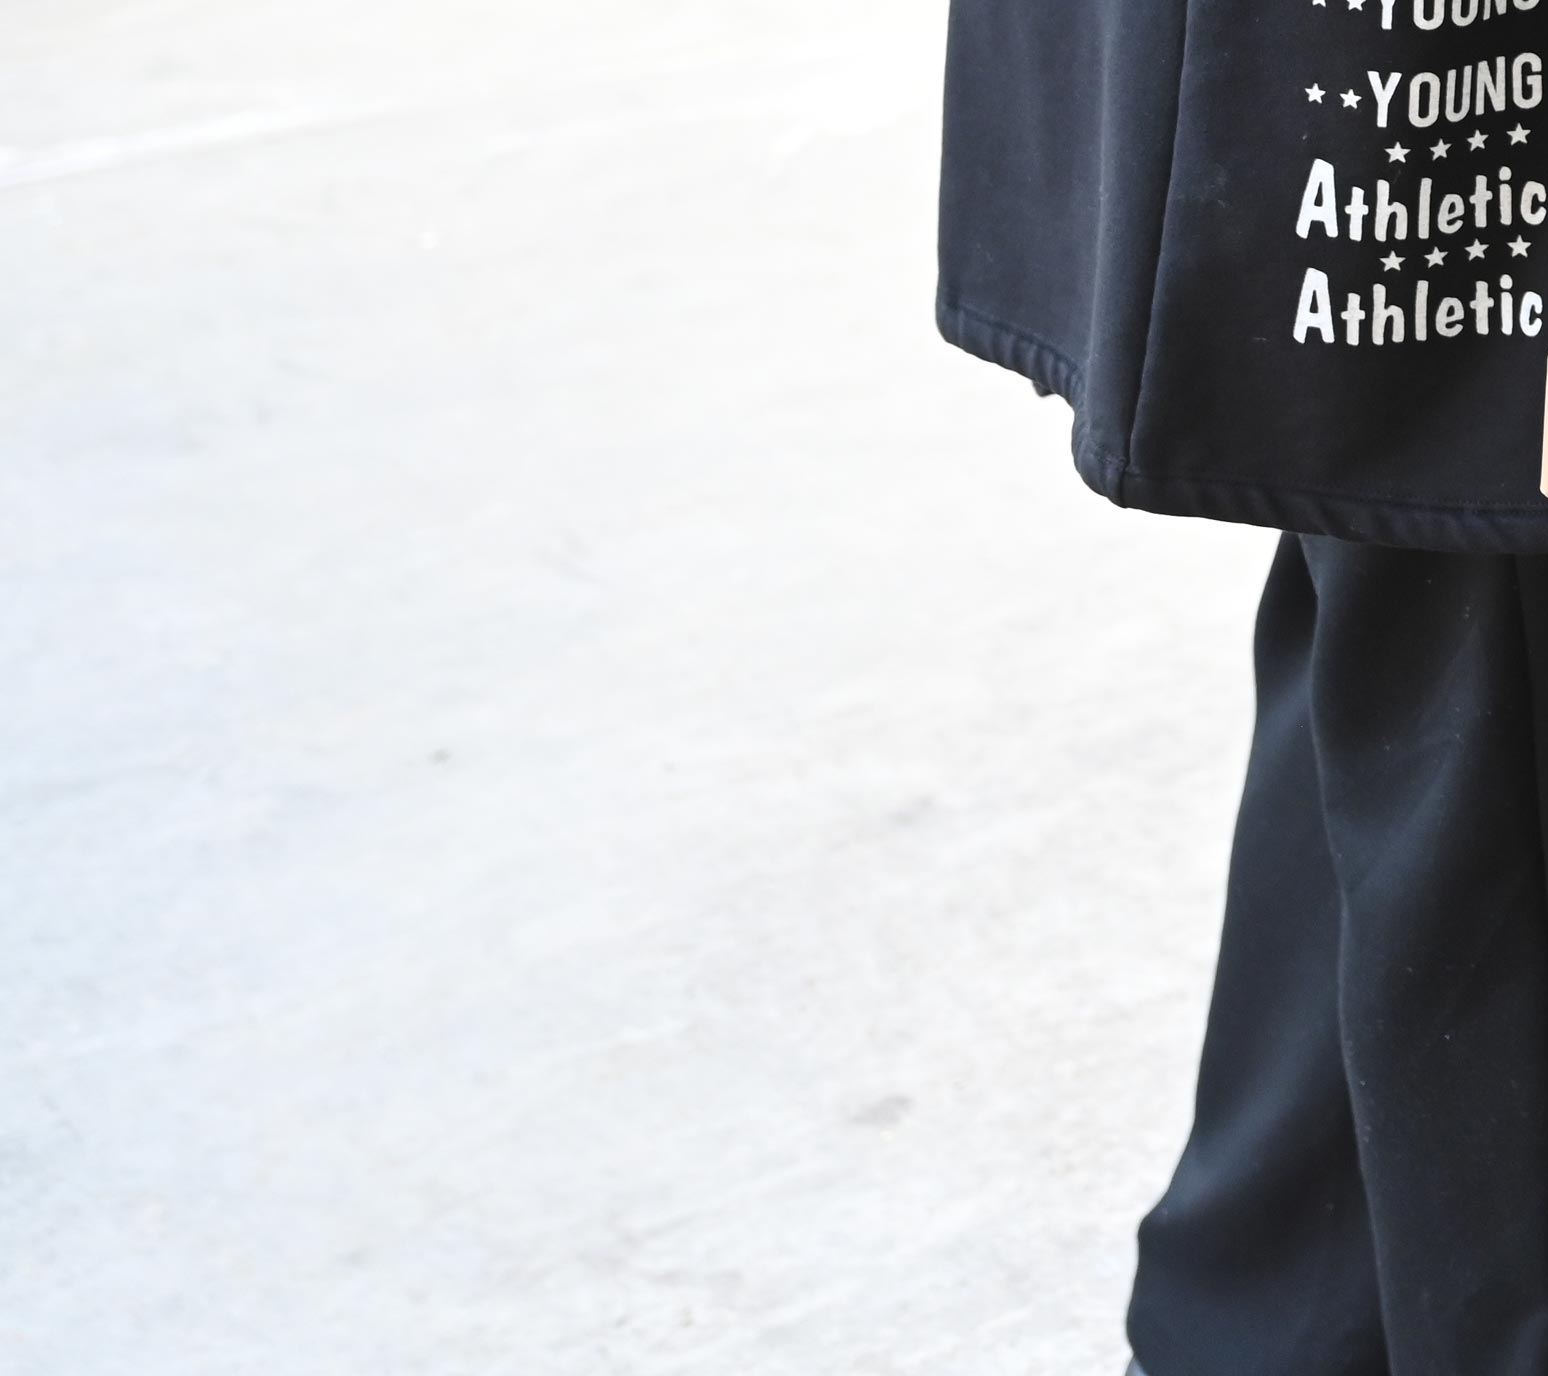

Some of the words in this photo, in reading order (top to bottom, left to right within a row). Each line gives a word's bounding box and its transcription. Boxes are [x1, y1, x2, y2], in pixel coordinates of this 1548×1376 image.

[1367, 51, 1542, 128] YOUNG
[1295, 157, 1547, 242] Athletic
[1292, 267, 1543, 346] Athletic
